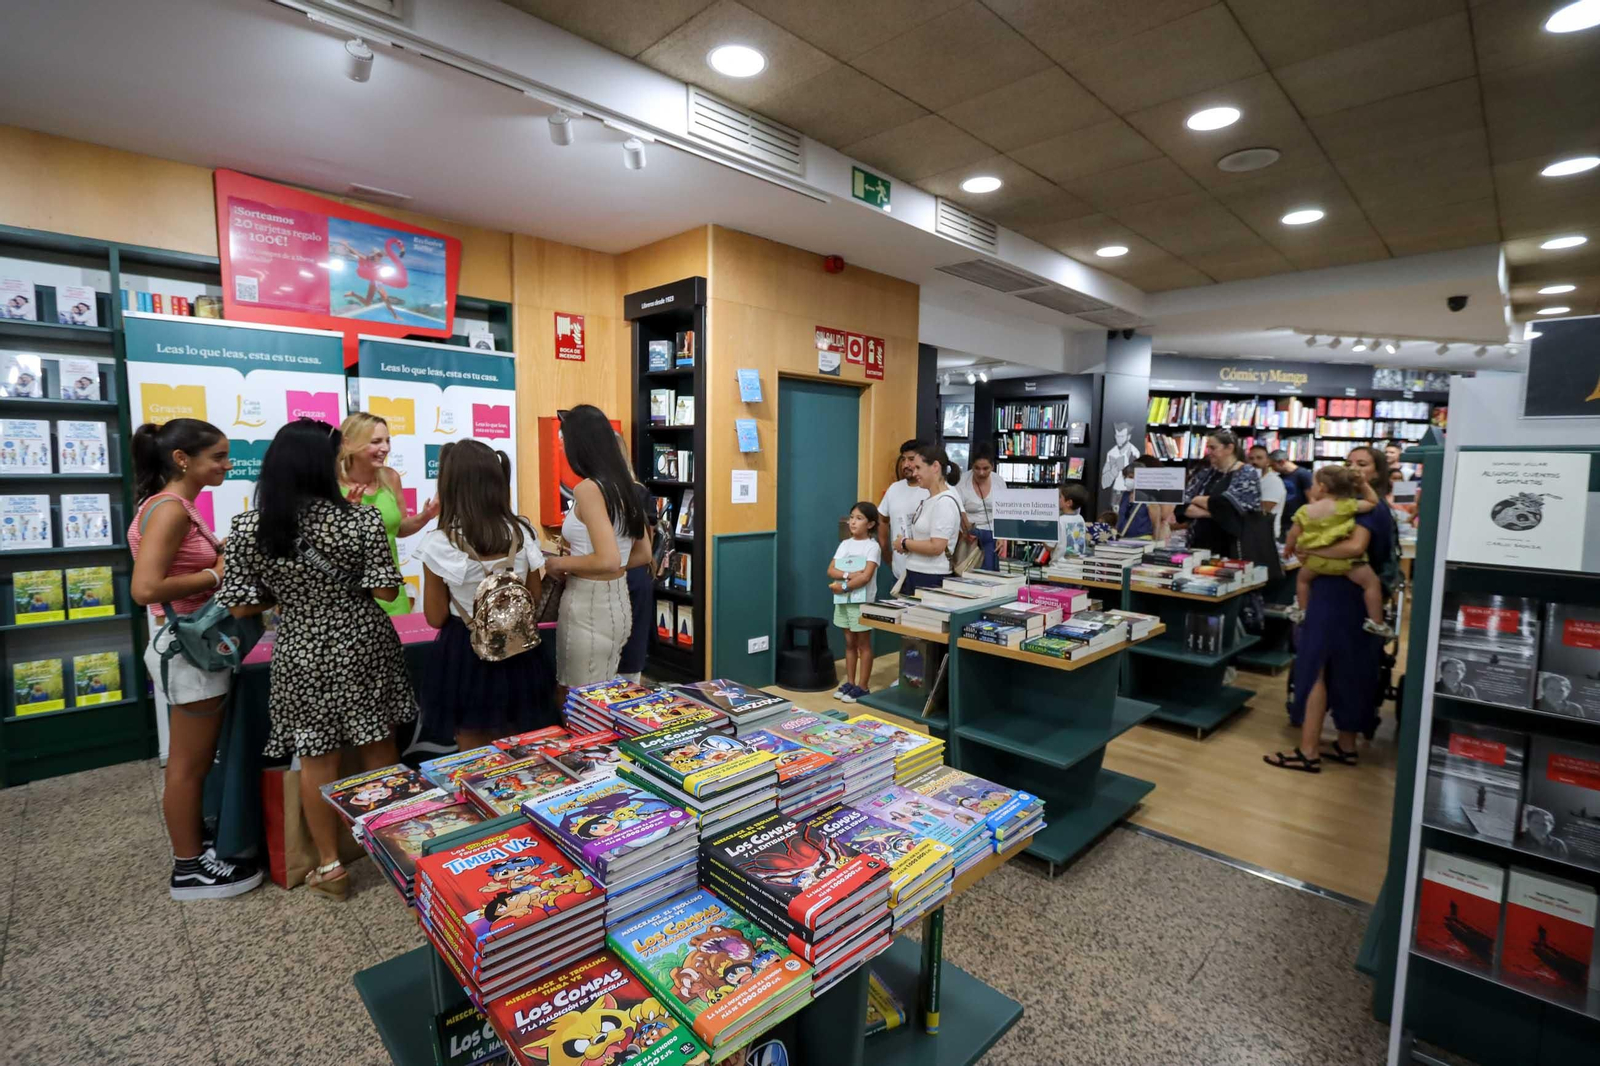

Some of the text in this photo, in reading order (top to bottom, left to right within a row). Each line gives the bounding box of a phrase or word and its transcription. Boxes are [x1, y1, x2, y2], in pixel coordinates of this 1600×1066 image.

[234, 217, 322, 243] 20 tarjetas regalo
[249, 232, 288, 246] 100€!
[156, 343, 322, 365] Leas lo que leas, esta es tu casa.
[380, 362, 401, 373] Leas
[401, 364, 410, 374] lo
[411, 367, 426, 377] que
[427, 366, 445, 377] leas,
[446, 370, 462, 379] esta
[472, 372, 480, 380] tu
[481, 374, 499, 382] casa.
[1220, 367, 1308, 386] Cómic y Manga
[149, 403, 193, 414] Gracias
[292, 408, 326, 418] Grazas
[228, 467, 246, 478] por
[639, 726, 708, 748] LOS COMPAS
[753, 814, 779, 828] TROLLINO
[823, 811, 861, 833] COMPAS
[850, 815, 869, 827] ESPACIO
[724, 837, 751, 858] LOS
[750, 820, 797, 846] COMPAS
[738, 828, 755, 840] TIMBA
[749, 847, 758, 857] LA
[758, 829, 798, 851] ENTIDAD.EXE
[450, 848, 466, 856] Los
[459, 842, 497, 857] favoritos
[443, 848, 510, 875] TIMBA
[672, 894, 704, 912] TROLLINO
[632, 904, 722, 953] LOS COMPAS
[652, 908, 685, 928] TIMBA VK
[649, 946, 660, 955] LA
[659, 931, 689, 948] CÁMARA
[689, 924, 703, 933] DEL
[702, 911, 728, 926] TIEMPO
[542, 974, 583, 997] TIMBA VK
[558, 974, 569, 982] EL
[514, 968, 623, 1028] LOS COMPAS
[526, 1022, 538, 1032] LA
[539, 1003, 579, 1027] MALDICIÓN
[579, 998, 589, 1006] DE
[589, 977, 630, 1001] MIKECRACK
[706, 1012, 715, 1020] LA
[715, 1005, 728, 1015] SAGA
[728, 991, 748, 1006] INFANTIL
[748, 984, 757, 993] QUE
[764, 967, 783, 982] VENDIDO
[721, 1009, 732, 1019] MÁS
[737, 982, 772, 1007] 1.000.000
[450, 1029, 481, 1058] LOS
[472, 1047, 487, 1060] VS.
[642, 1055, 653, 1064] HA
[652, 1035, 678, 1056] VENDIDO
